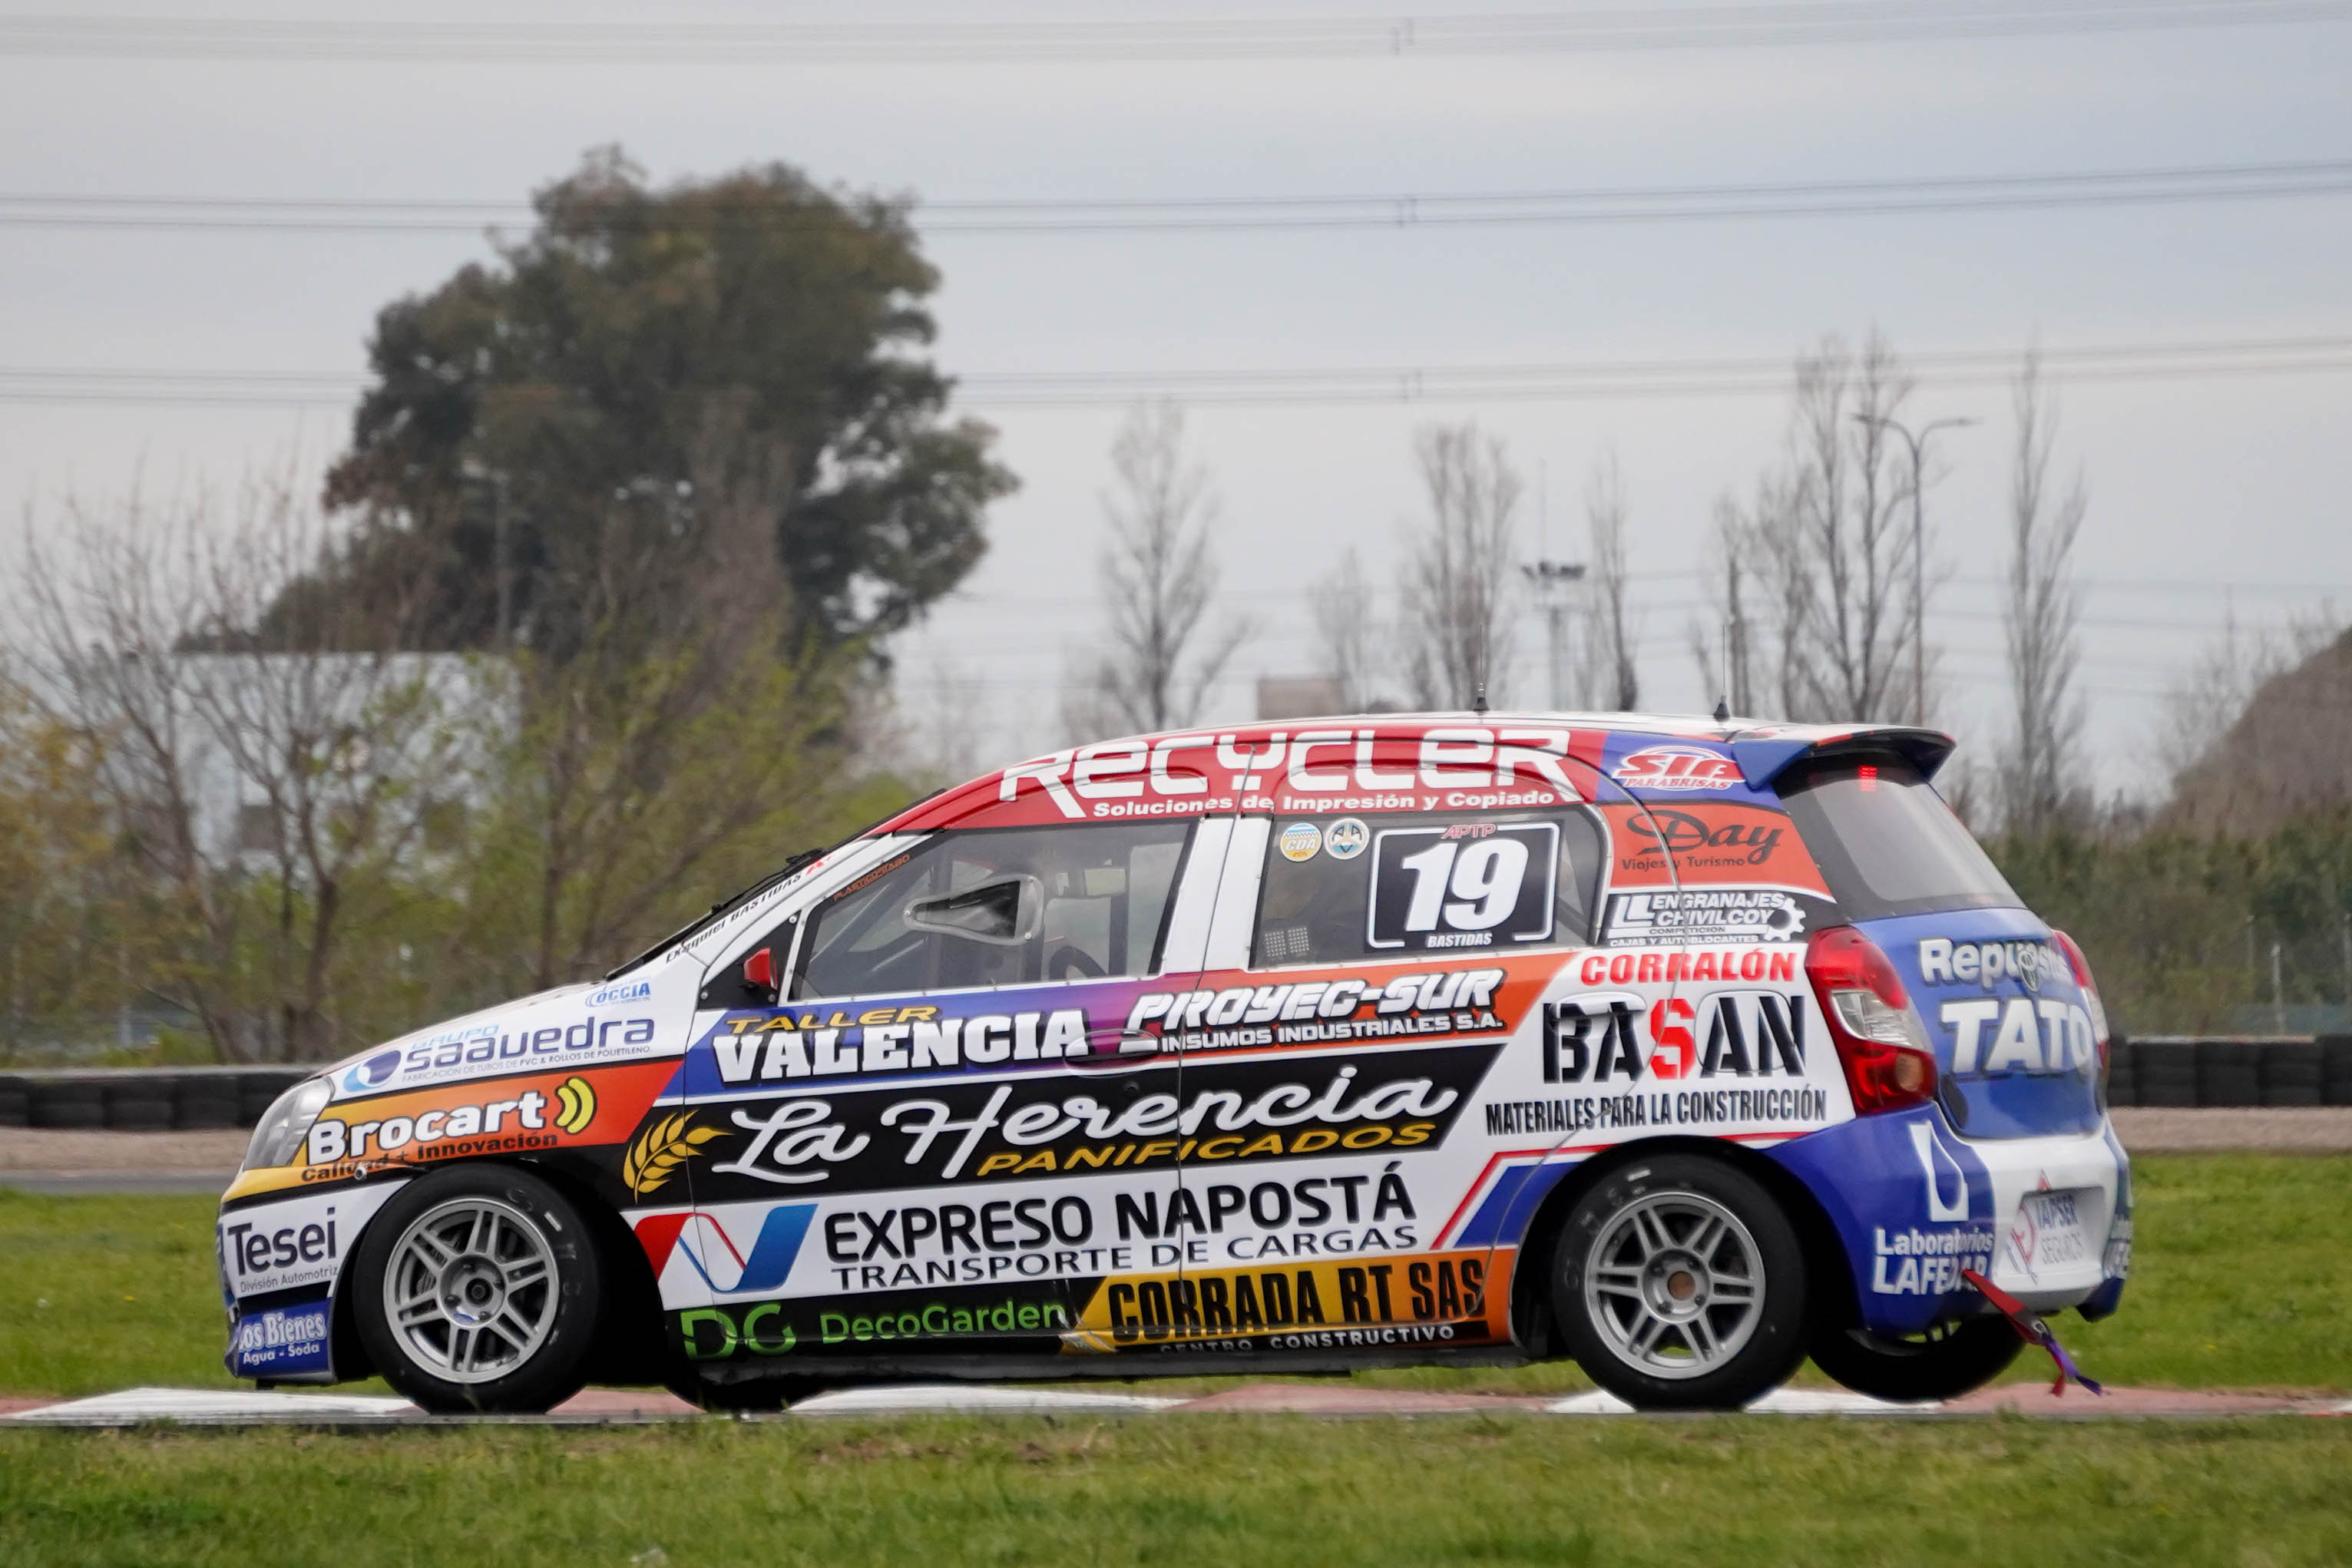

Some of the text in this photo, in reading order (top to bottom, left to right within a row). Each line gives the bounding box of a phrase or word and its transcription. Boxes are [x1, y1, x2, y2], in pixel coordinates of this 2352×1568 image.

[1623, 777, 1730, 789] PARABRISAS
[1093, 790, 1554, 817] Soluciones de Impresión y Copiado
[1441, 823, 1497, 839] APTP
[1626, 809, 1784, 865] Day
[1622, 858, 1666, 872] Viajes
[1686, 855, 1745, 867] Turismo
[1402, 839, 1529, 931] 19
[1652, 892, 1785, 910] ENGRANAJES
[1656, 909, 1775, 926] CHIVILCOY
[1426, 932, 1493, 948] BASTIDAS
[1609, 938, 1646, 947] CAJAS
[1650, 938, 1659, 946] Y
[1580, 947, 1798, 985] CORRALÓN
[726, 1006, 943, 1035] TALLER
[1120, 968, 1506, 1053] PROYEC-SUR
[712, 1009, 1090, 1083] VALENCIA
[1161, 1011, 1503, 1053] INSUMOS INDUSTRIALES S.A.
[1542, 995, 1805, 1084] BASAN
[1941, 999, 2094, 1073] TATO
[463, 1064, 475, 1075] DE
[505, 1058, 518, 1069] DE
[519, 1057, 538, 1067] PVC
[548, 1051, 581, 1063] ROLLOS
[584, 1050, 595, 1060] DE
[308, 1090, 546, 1166] Brocart
[711, 1064, 1458, 1184] La Herencia
[1485, 1083, 1827, 1136] MATERIALES PARA LA CONSTRUCCIÓN
[976, 1123, 1437, 1177] PANIFICADOS
[824, 1160, 1417, 1264] EXPRESO NAPOSTÁ
[227, 1207, 336, 1276] Tesei
[831, 1225, 1418, 1291] TRANSPORTE DE CARGAS
[1876, 1227, 1994, 1255] Laboratorios
[240, 1265, 339, 1293] División Automotriz
[1108, 1259, 1487, 1342] CORRADA RT SAS
[263, 1312, 327, 1348] Bienes
[819, 1300, 1067, 1346] DecoGarden
[1270, 1325, 1455, 1350] CONSTRUCTIVO
[243, 1351, 276, 1365] Agua
[288, 1342, 320, 1358] Soda
